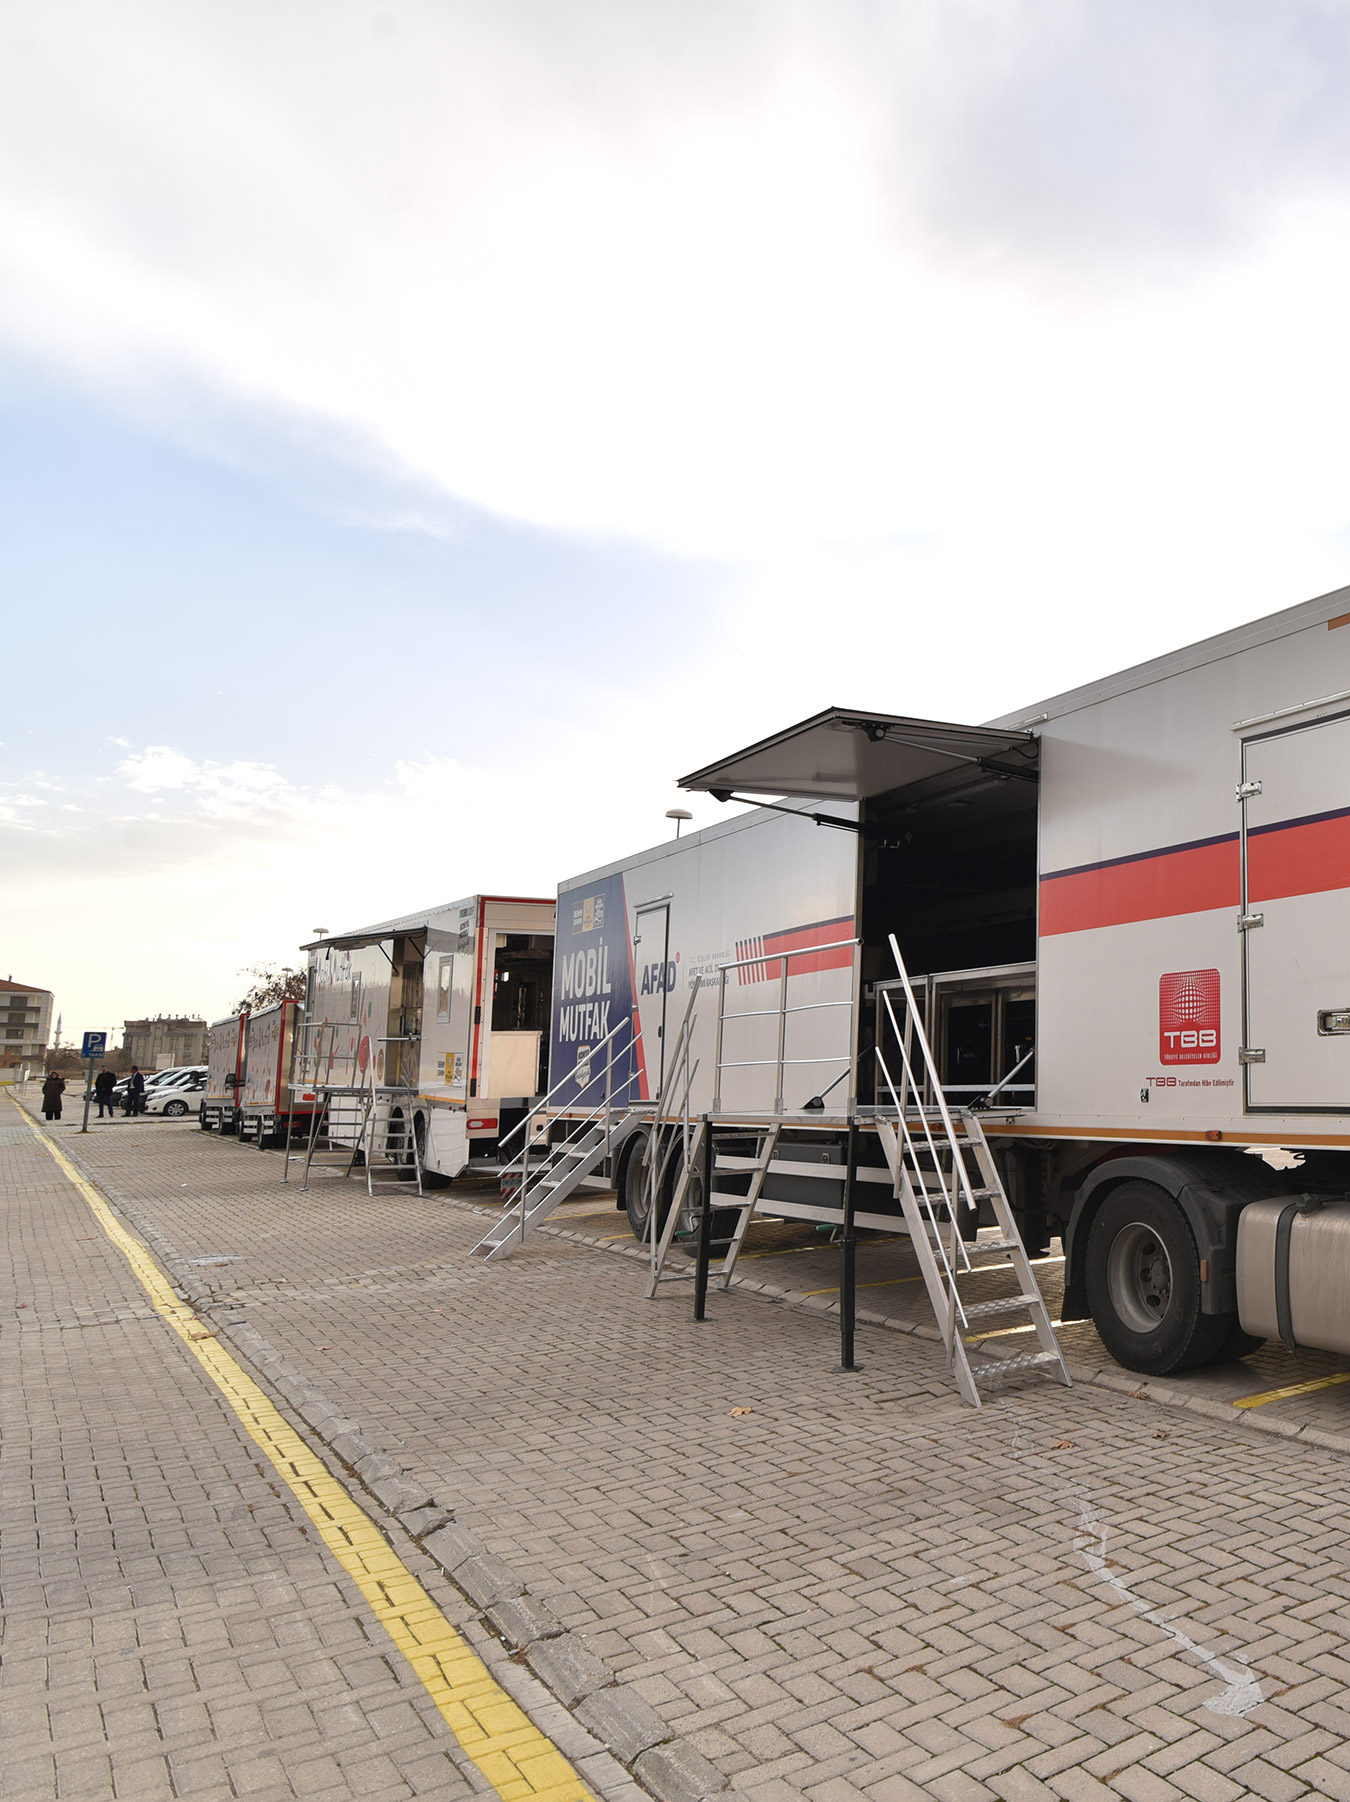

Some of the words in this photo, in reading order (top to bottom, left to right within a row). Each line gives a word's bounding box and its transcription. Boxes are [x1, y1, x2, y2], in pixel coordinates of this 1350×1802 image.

[561, 936, 612, 1001] MOBİL
[640, 960, 677, 996] AFAD
[559, 1000, 611, 1043] MUTFAK
[88, 1034, 102, 1048] P
[1164, 1029, 1217, 1048] TBB
[1146, 1077, 1177, 1087] TBB
[1202, 1079, 1212, 1087] Hibe
